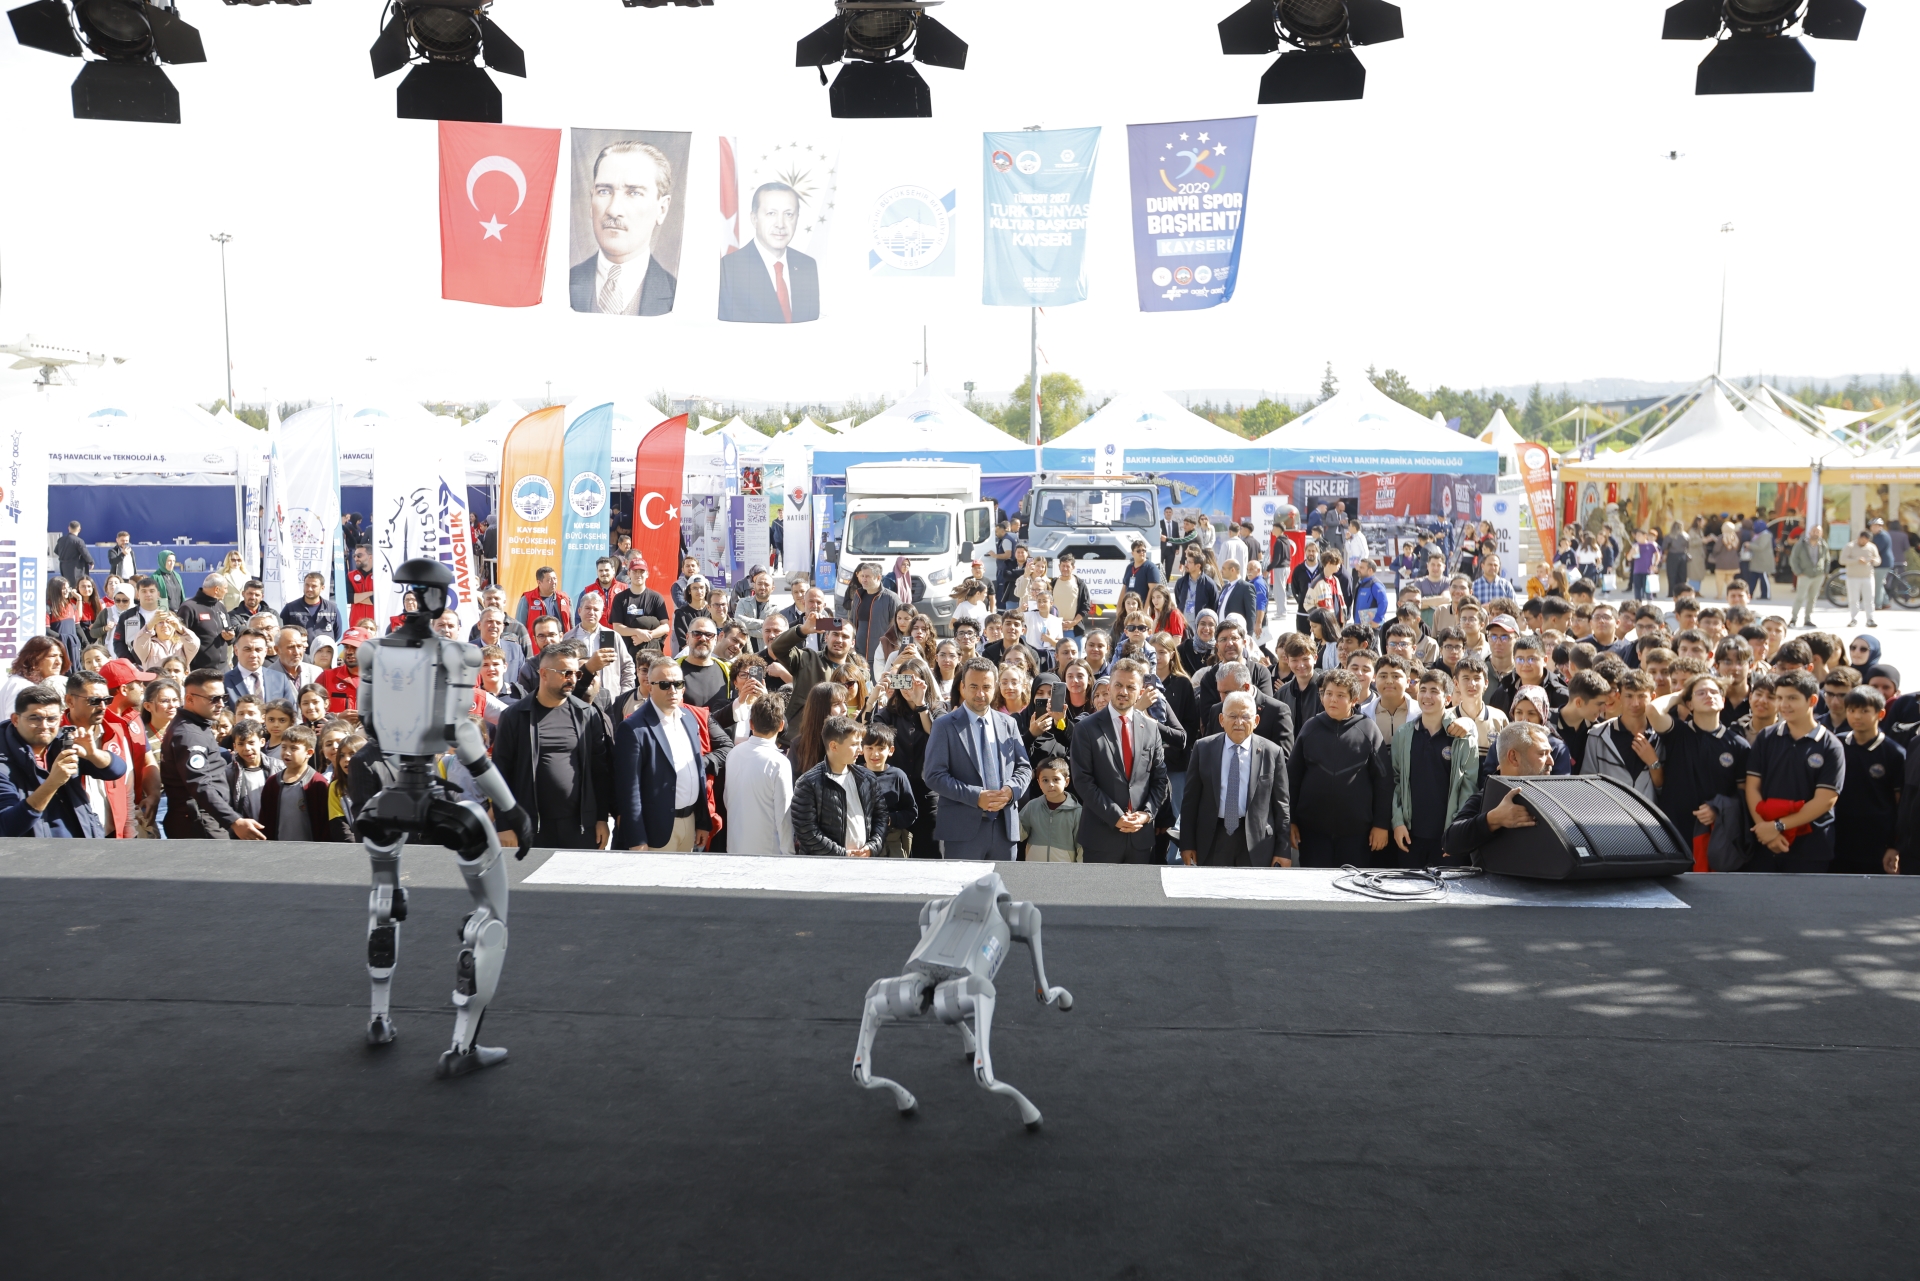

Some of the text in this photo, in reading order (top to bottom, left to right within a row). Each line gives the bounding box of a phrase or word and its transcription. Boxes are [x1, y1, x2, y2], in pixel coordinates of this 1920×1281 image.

[1178, 182, 1210, 194] 2029
[1146, 192, 1243, 213] DÜNYA SPOR
[991, 202, 1089, 218] TÜRK DÜNYAS
[1036, 218, 1087, 232] BAŞKENT
[1147, 210, 1241, 237] BAŞKENTİ
[1012, 232, 1072, 246] KAYSERİ
[1161, 239, 1231, 254] KAYSERİ
[49, 453, 62, 461] TAŞ
[113, 453, 152, 461] TEKNOLOJİ
[1152, 455, 1184, 463] FABRİKA
[1186, 455, 1234, 463] MÜDÜRLÜĞÜ
[1332, 456, 1352, 464] HAVA
[1380, 456, 1412, 465] FABRİKA
[1414, 456, 1463, 466] MÜDÜRLÜĞÜ
[516, 526, 548, 534] KAYSERİ
[573, 521, 600, 529] KAYSERİ
[565, 532, 607, 540] BÜYÜKŞEHİR
[1496, 528, 1511, 540] 00.
[508, 535, 557, 545] BÜYÜKŞEHİR
[511, 547, 554, 556] BELEDİYESİ
[567, 543, 606, 551] BELEDİYESİ
[1498, 542, 1509, 553] IL
[267, 546, 323, 560] KSERİ
[449, 511, 472, 603] HAVACILIK
[1090, 588, 1112, 596] ÇEKER
[22, 560, 35, 637] KAYSERİ
